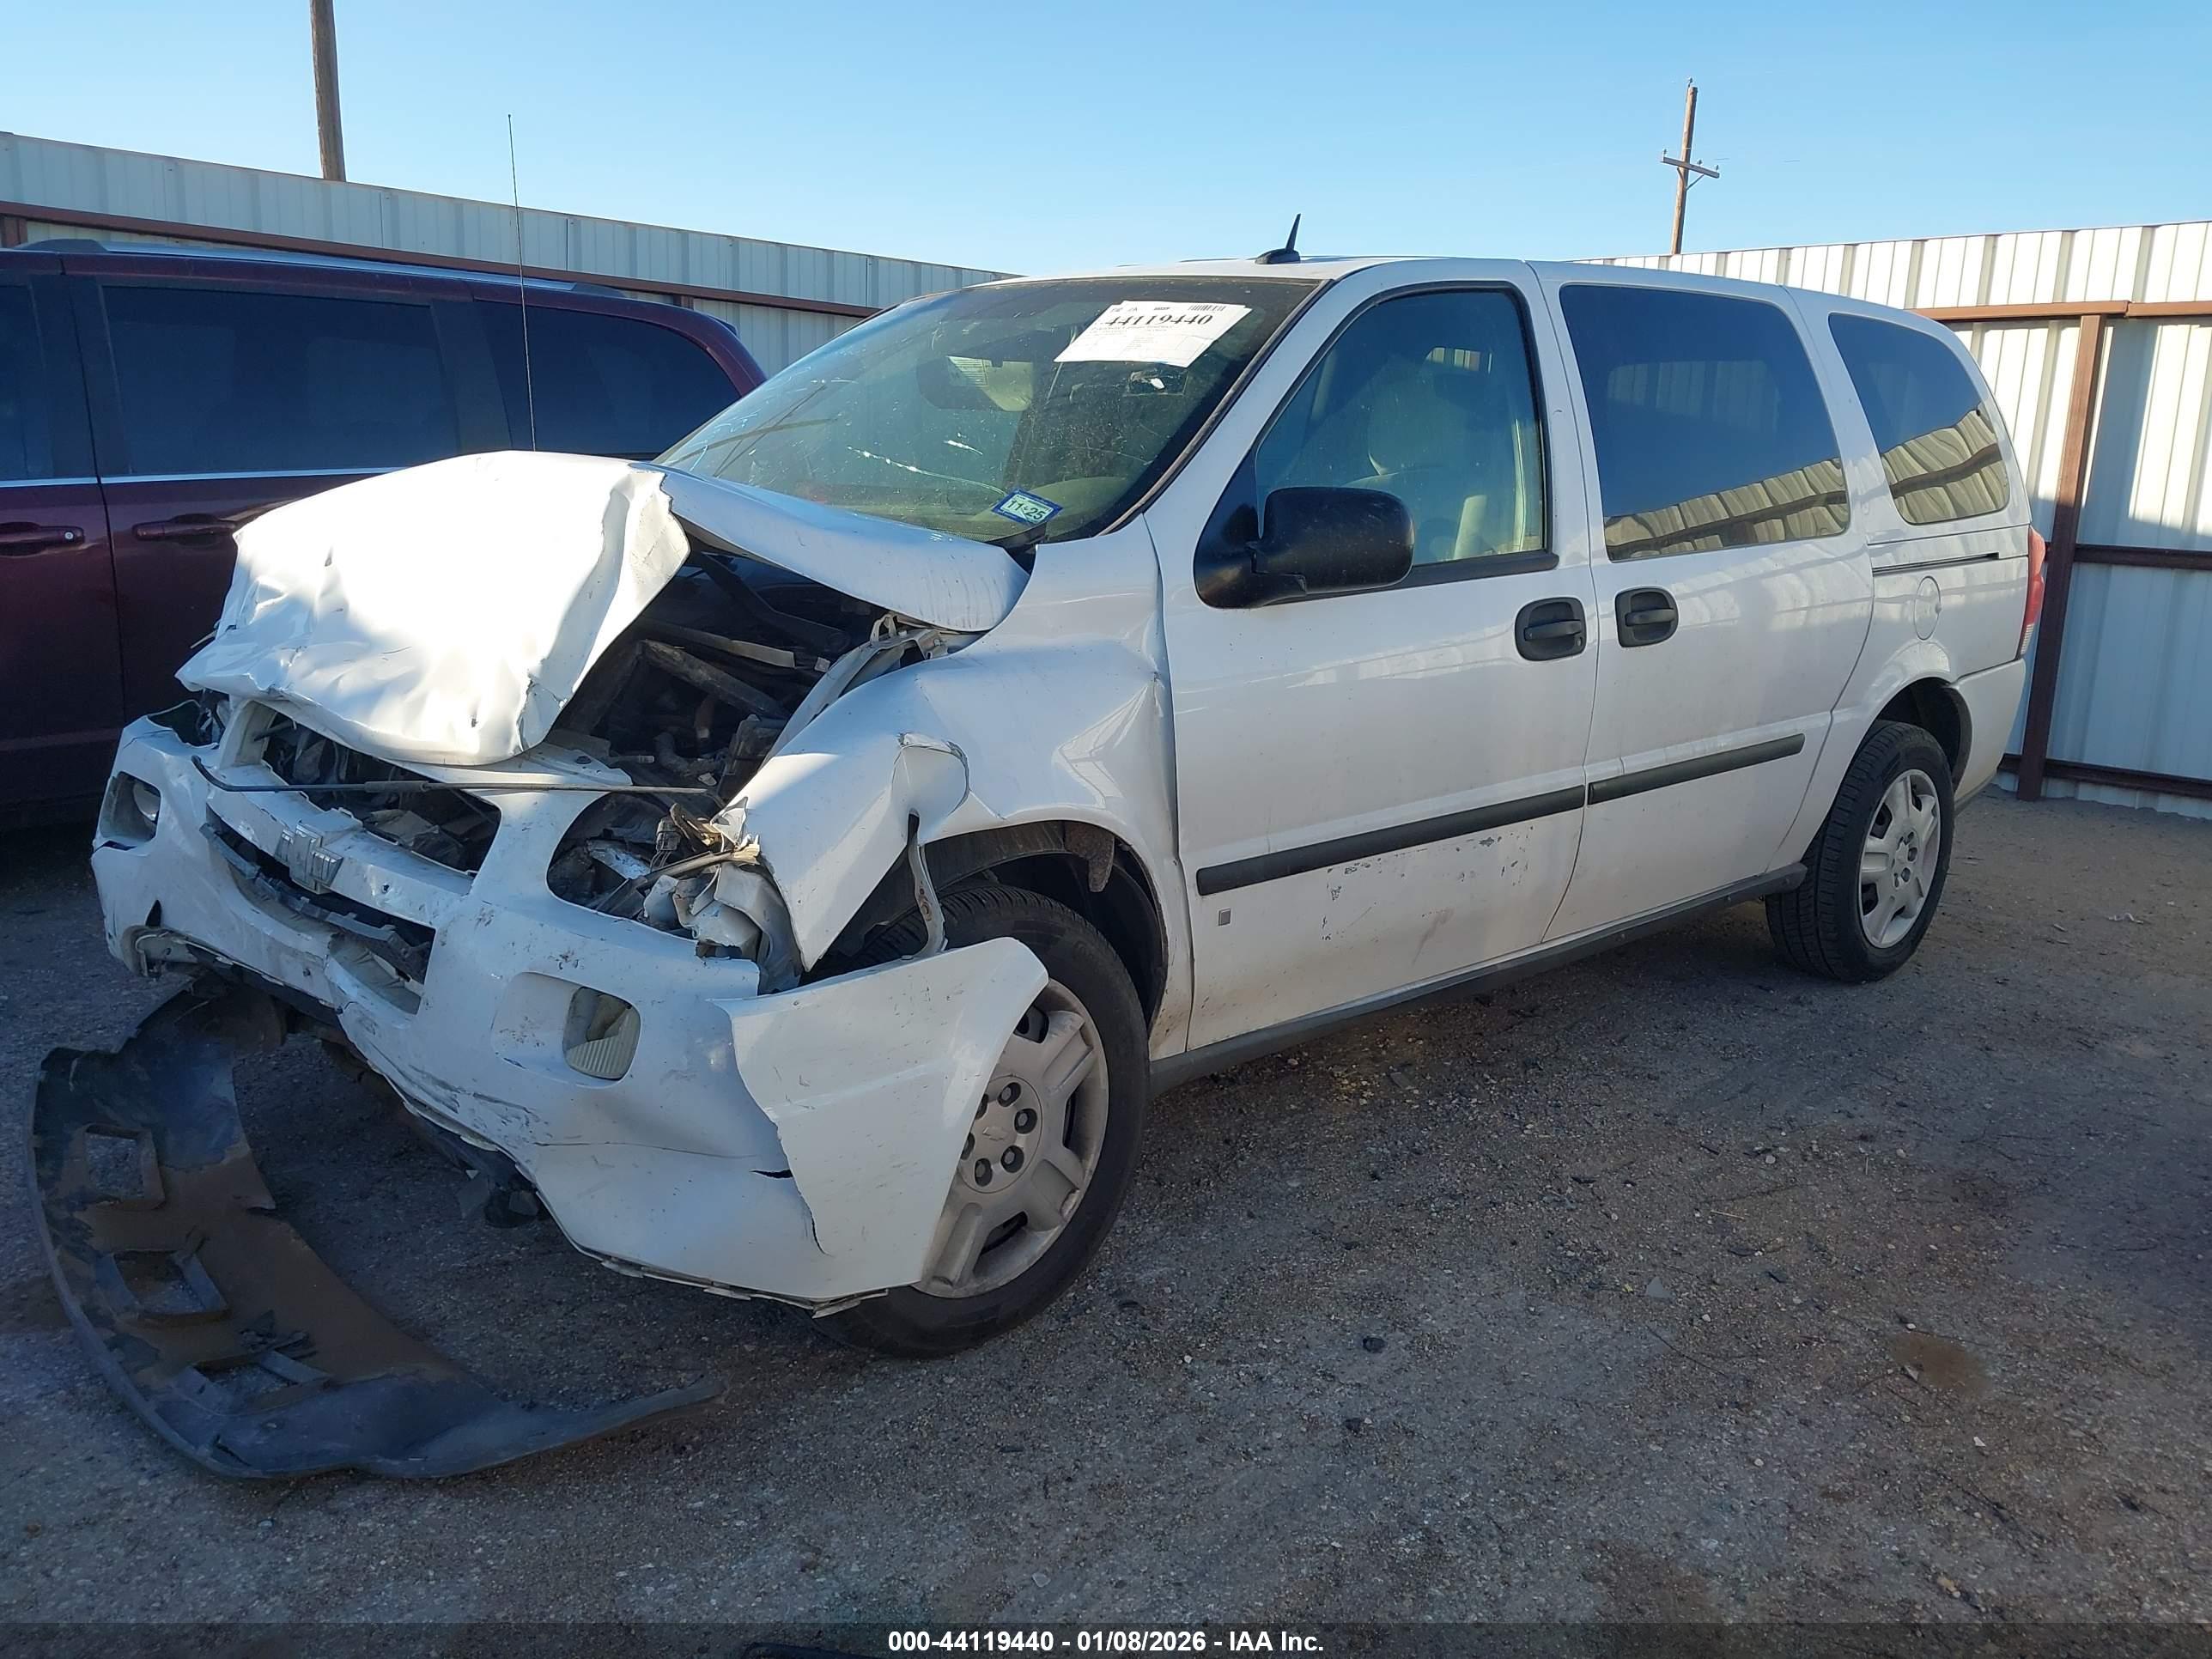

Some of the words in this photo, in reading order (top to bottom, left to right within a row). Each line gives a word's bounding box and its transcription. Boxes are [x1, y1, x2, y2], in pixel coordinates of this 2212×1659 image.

[1105, 314, 1213, 326] 44119440
[1007, 500, 1024, 511] 11
[1024, 507, 1046, 520] 25
